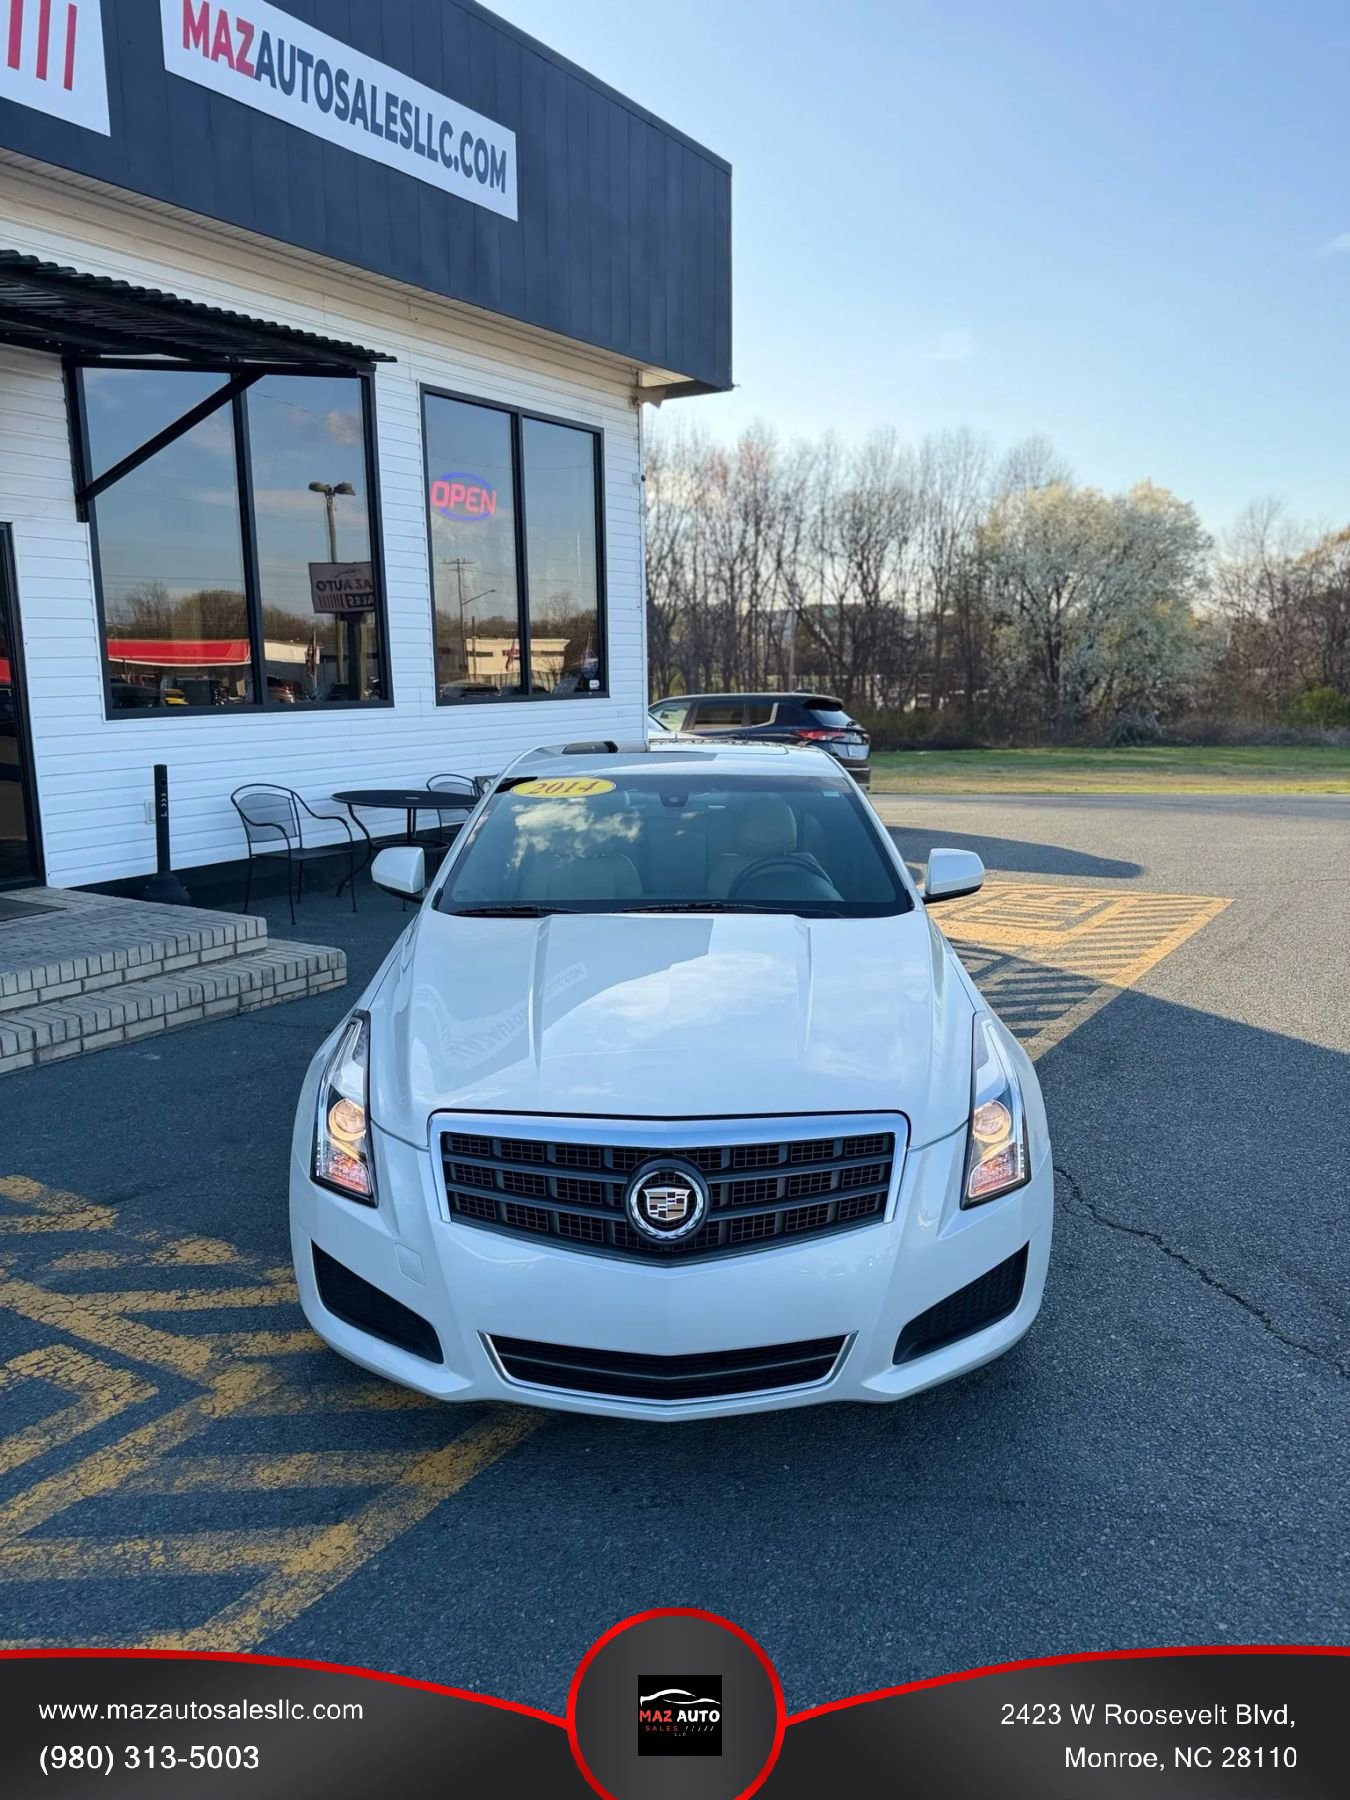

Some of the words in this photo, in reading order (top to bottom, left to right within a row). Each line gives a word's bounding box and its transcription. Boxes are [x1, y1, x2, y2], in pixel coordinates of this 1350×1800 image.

[183, 0, 507, 194] MAZAUTOSALESLLC.COM
[431, 480, 496, 516] OPEN
[527, 780, 600, 795] 2014
